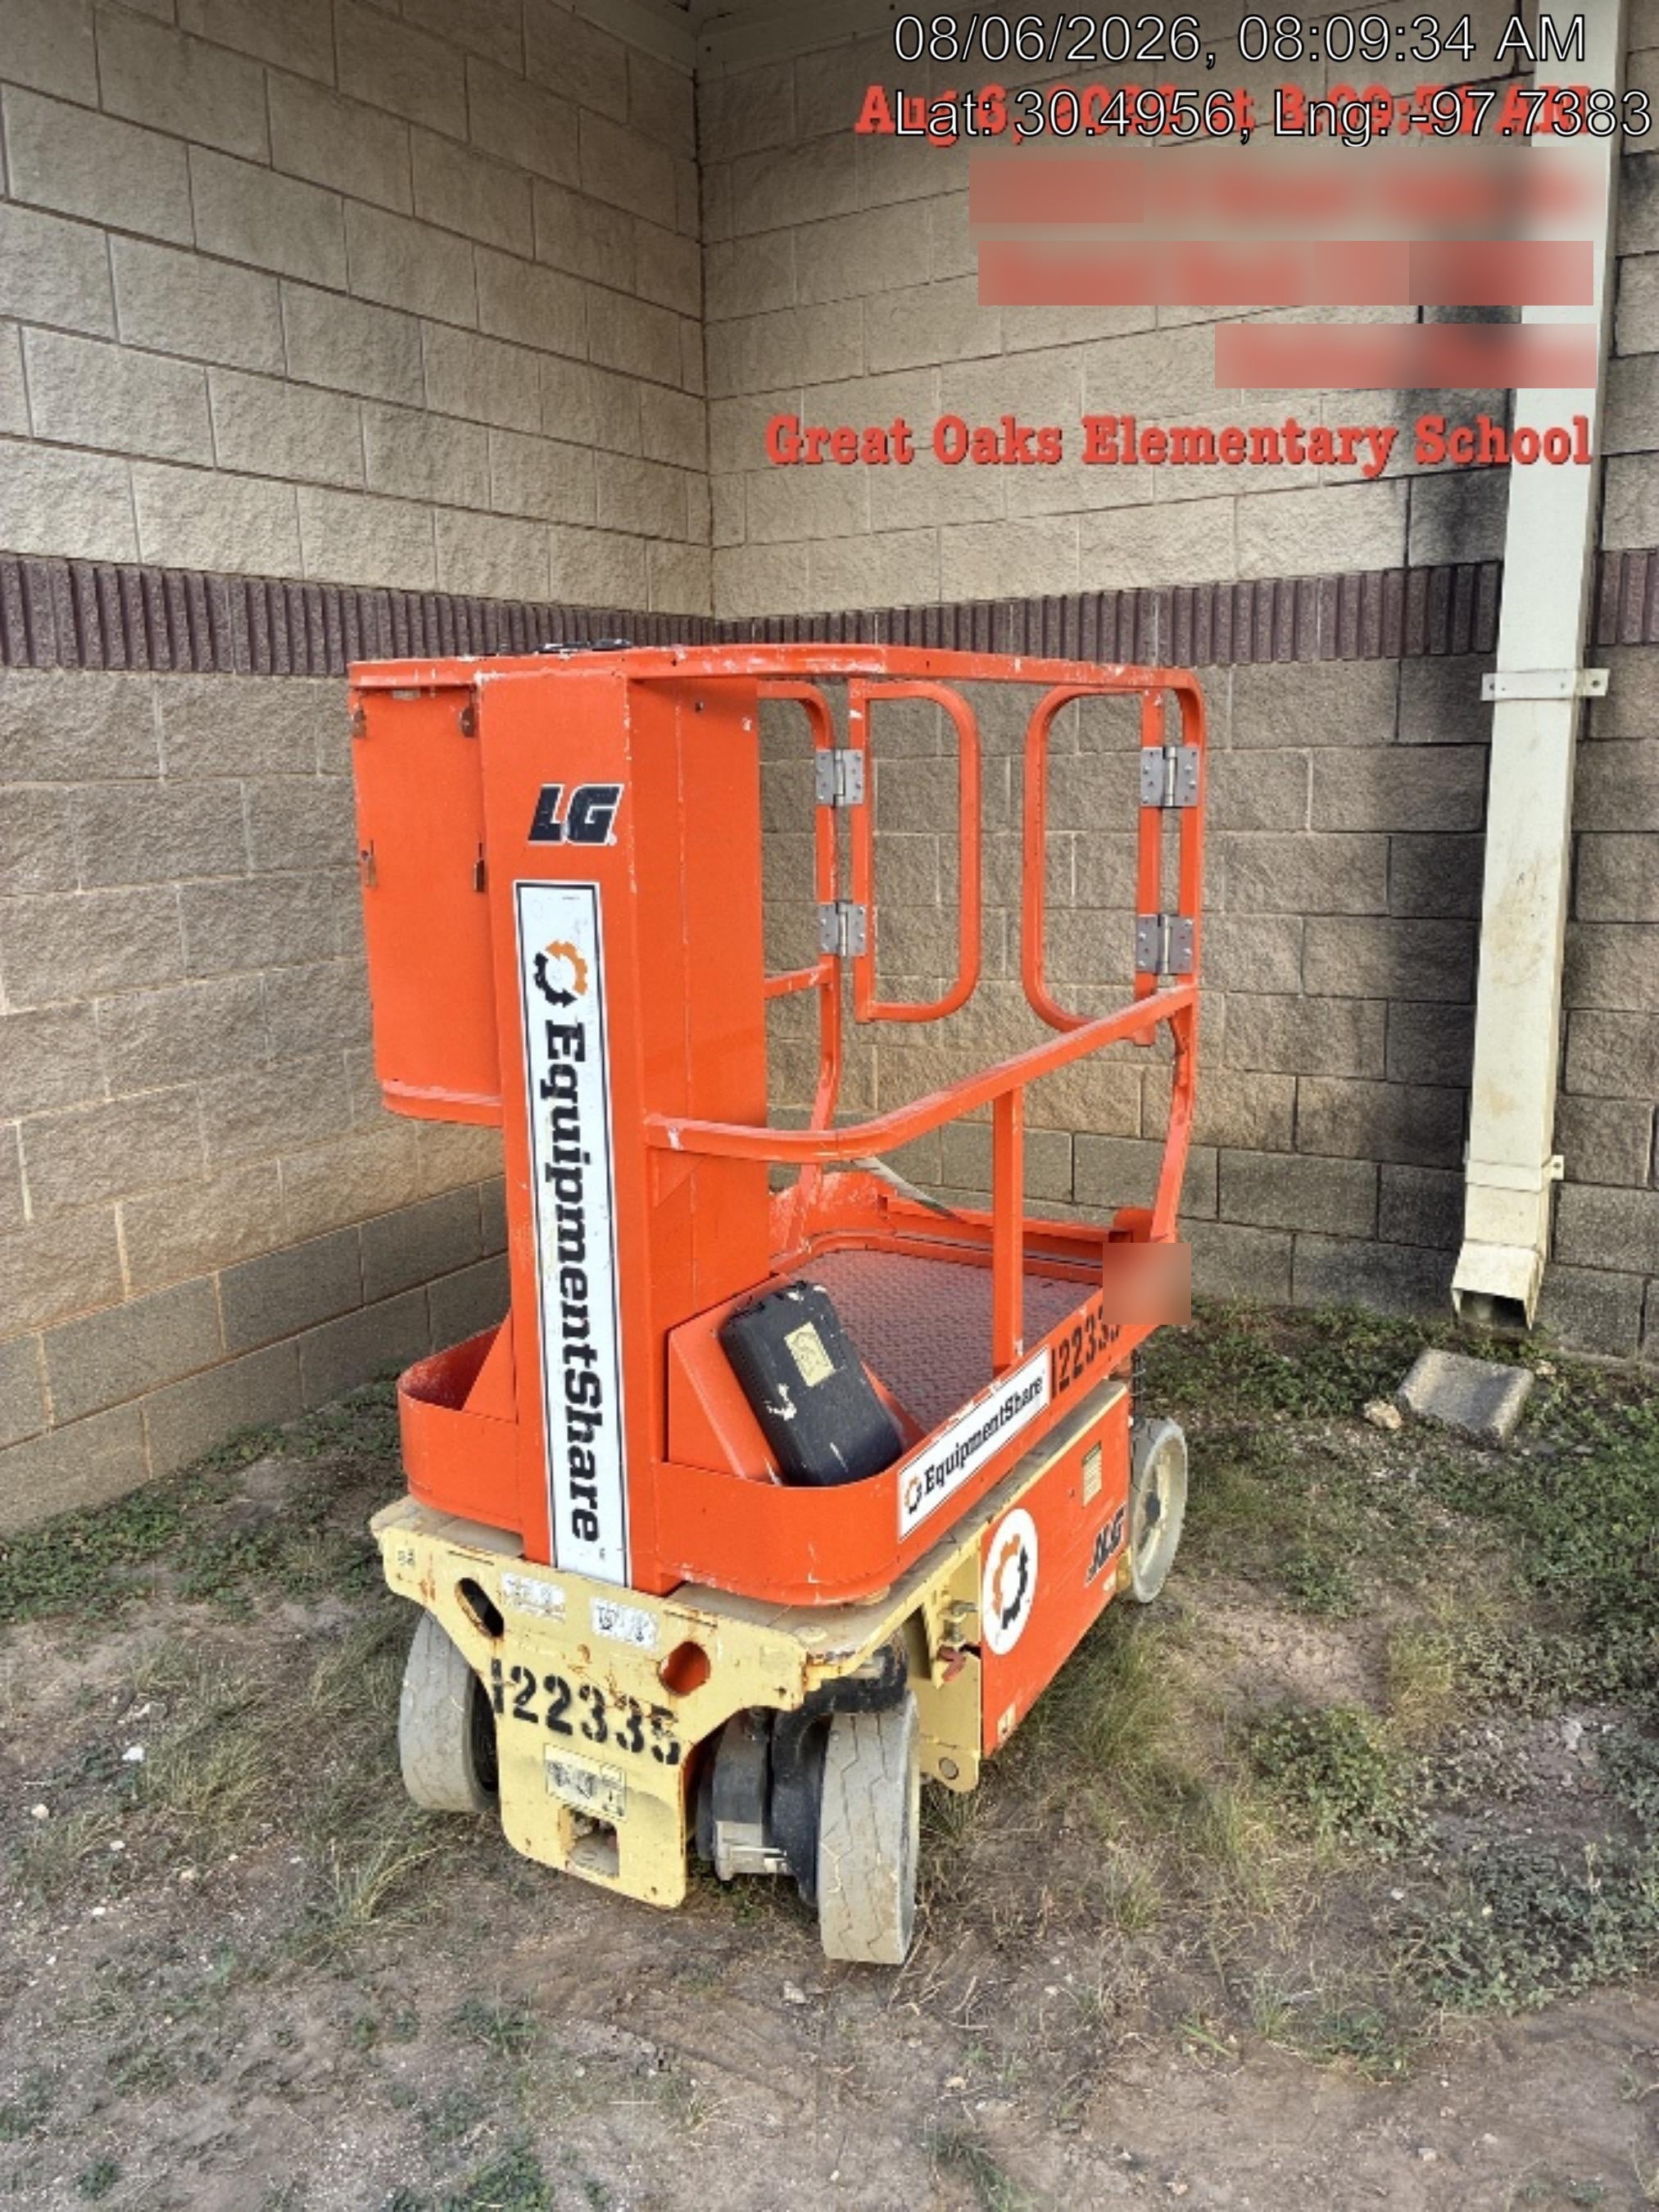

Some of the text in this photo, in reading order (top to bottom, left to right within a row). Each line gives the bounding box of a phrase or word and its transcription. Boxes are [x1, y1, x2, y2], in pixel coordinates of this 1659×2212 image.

[540, 1020, 603, 1543] EquipmentShare
[924, 1376, 1044, 1495] EquipmentShare
[492, 1658, 681, 1766] 122335
